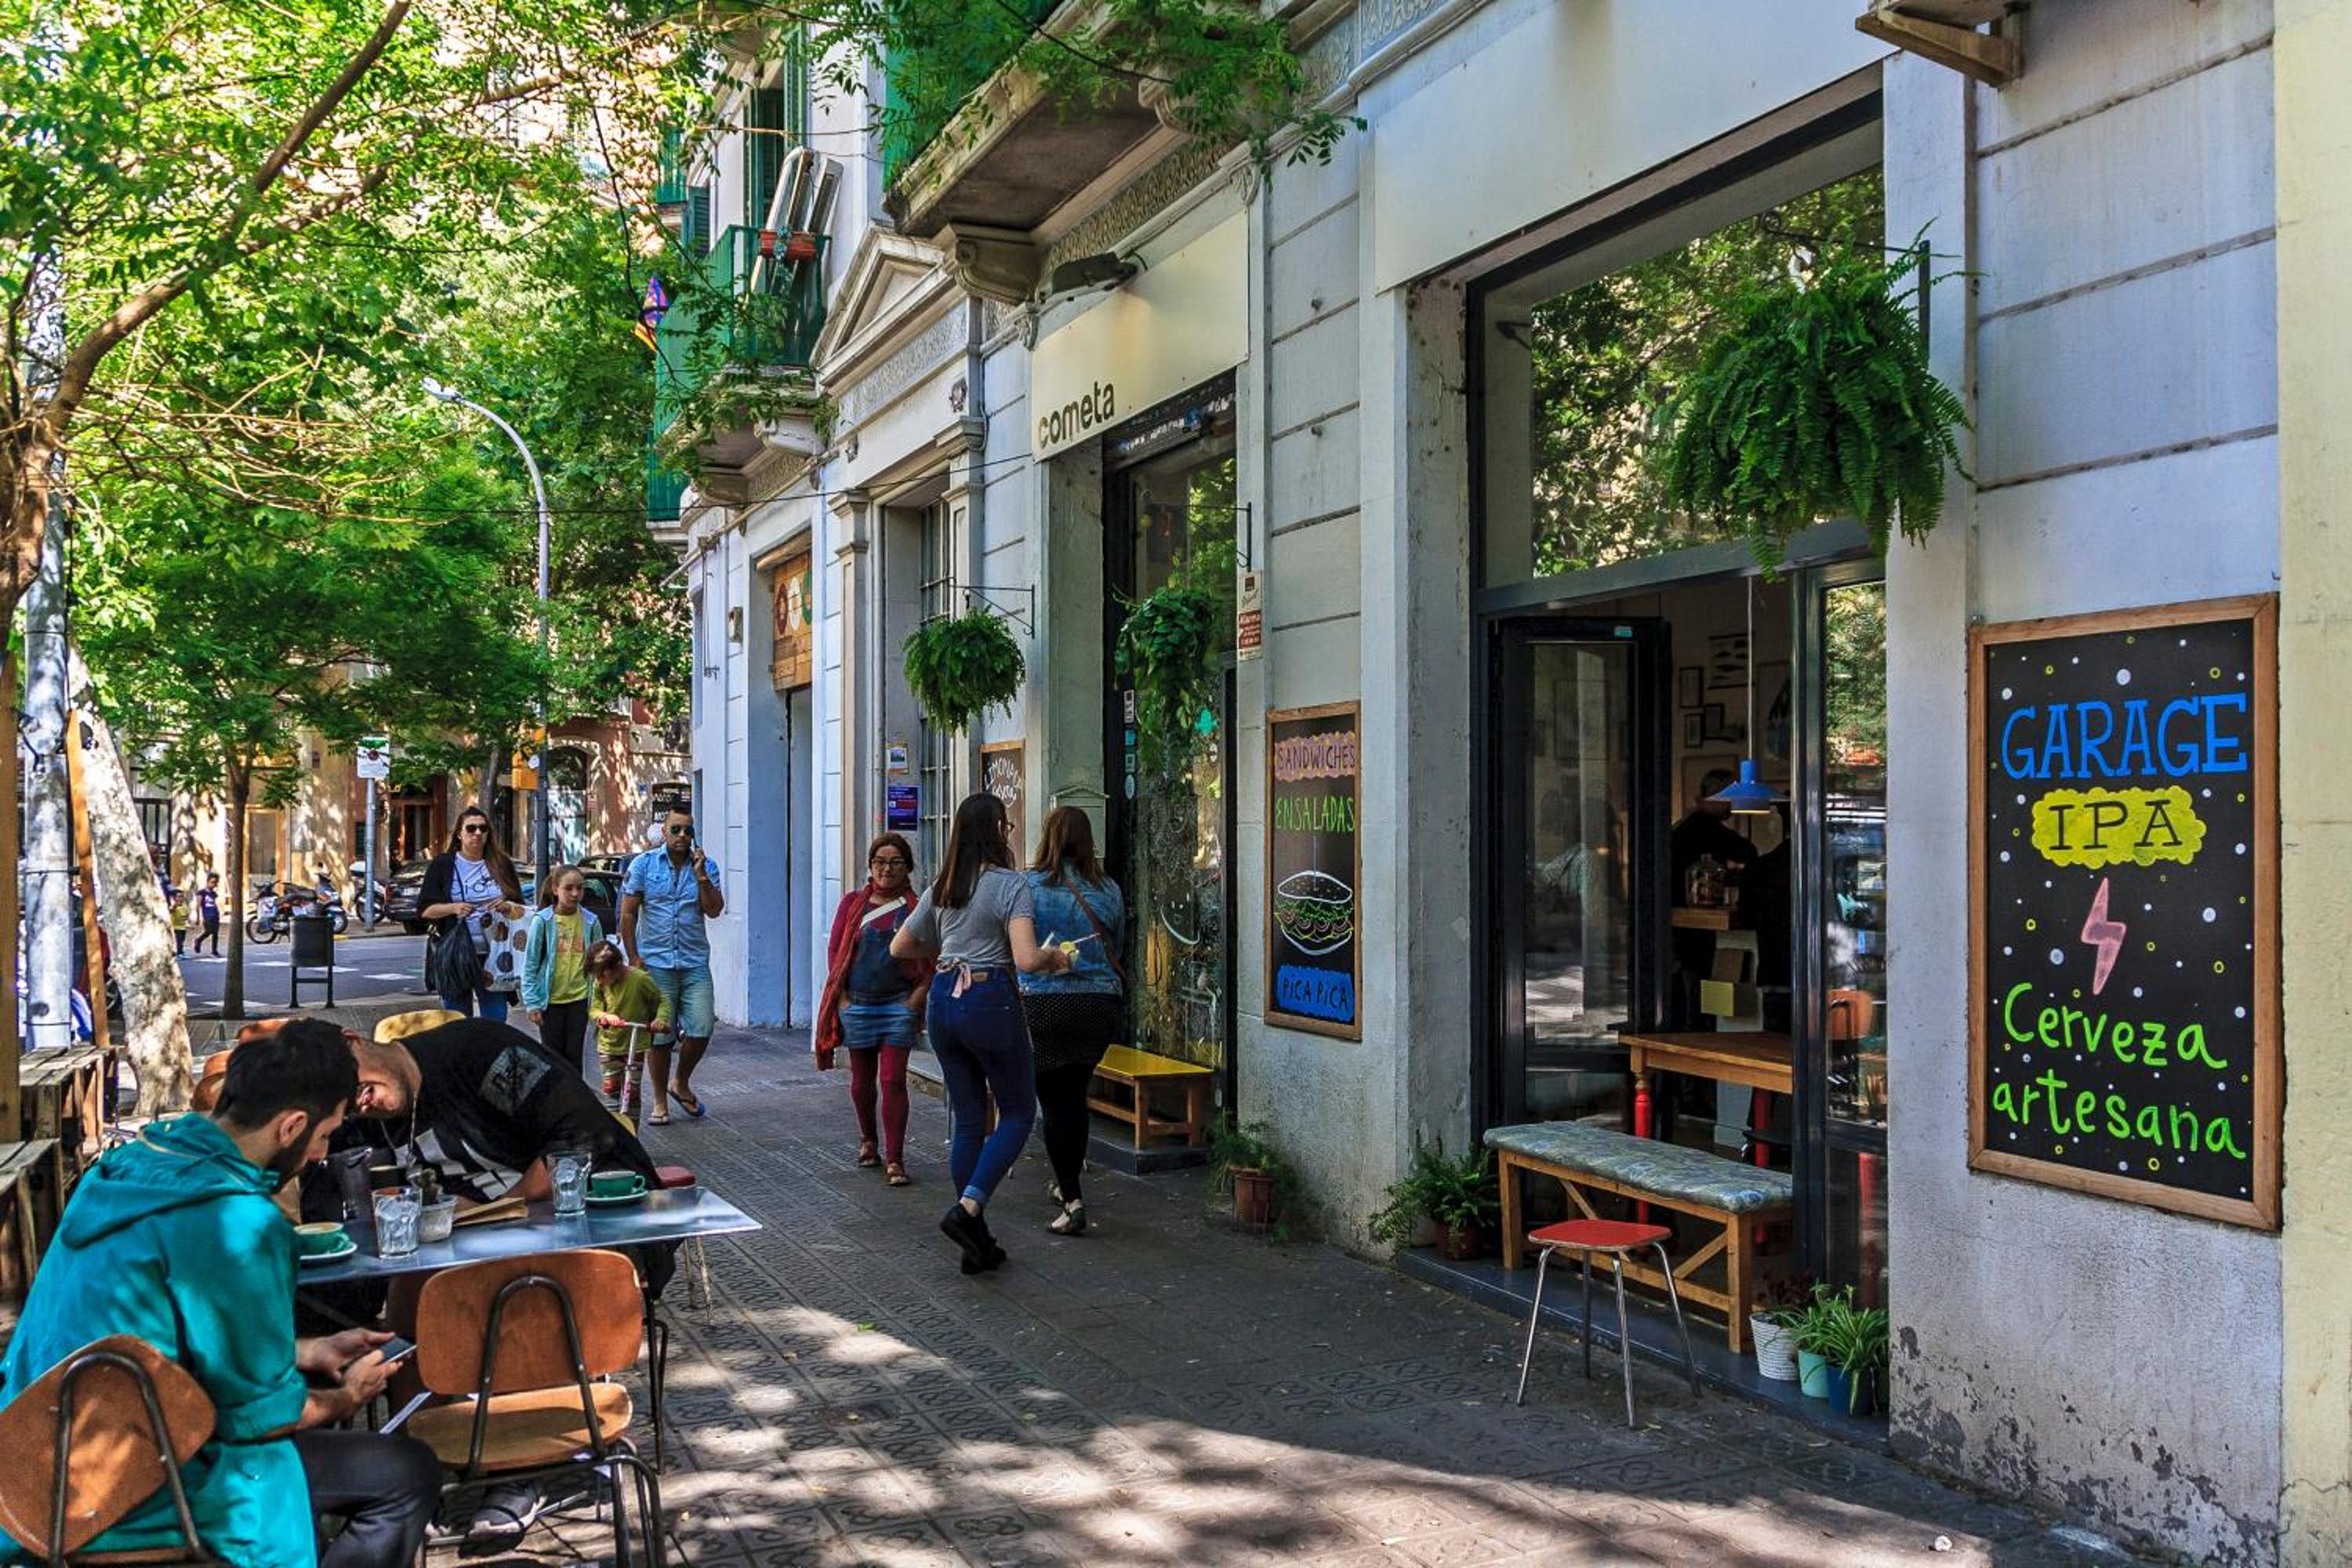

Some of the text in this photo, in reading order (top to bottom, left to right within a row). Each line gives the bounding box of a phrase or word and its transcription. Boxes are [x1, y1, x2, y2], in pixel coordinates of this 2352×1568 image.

[1037, 380, 1115, 449] cometa
[1278, 745, 1355, 770] SANDWICHES
[2002, 693, 2246, 779] GARAGE
[1276, 796, 1355, 833] ENSALADAS
[2048, 798, 2184, 851] IPA
[1283, 974, 1348, 1011] PICA PICA
[2004, 982, 2227, 1069] Cerveza
[1992, 1068, 2246, 1160] artesana
